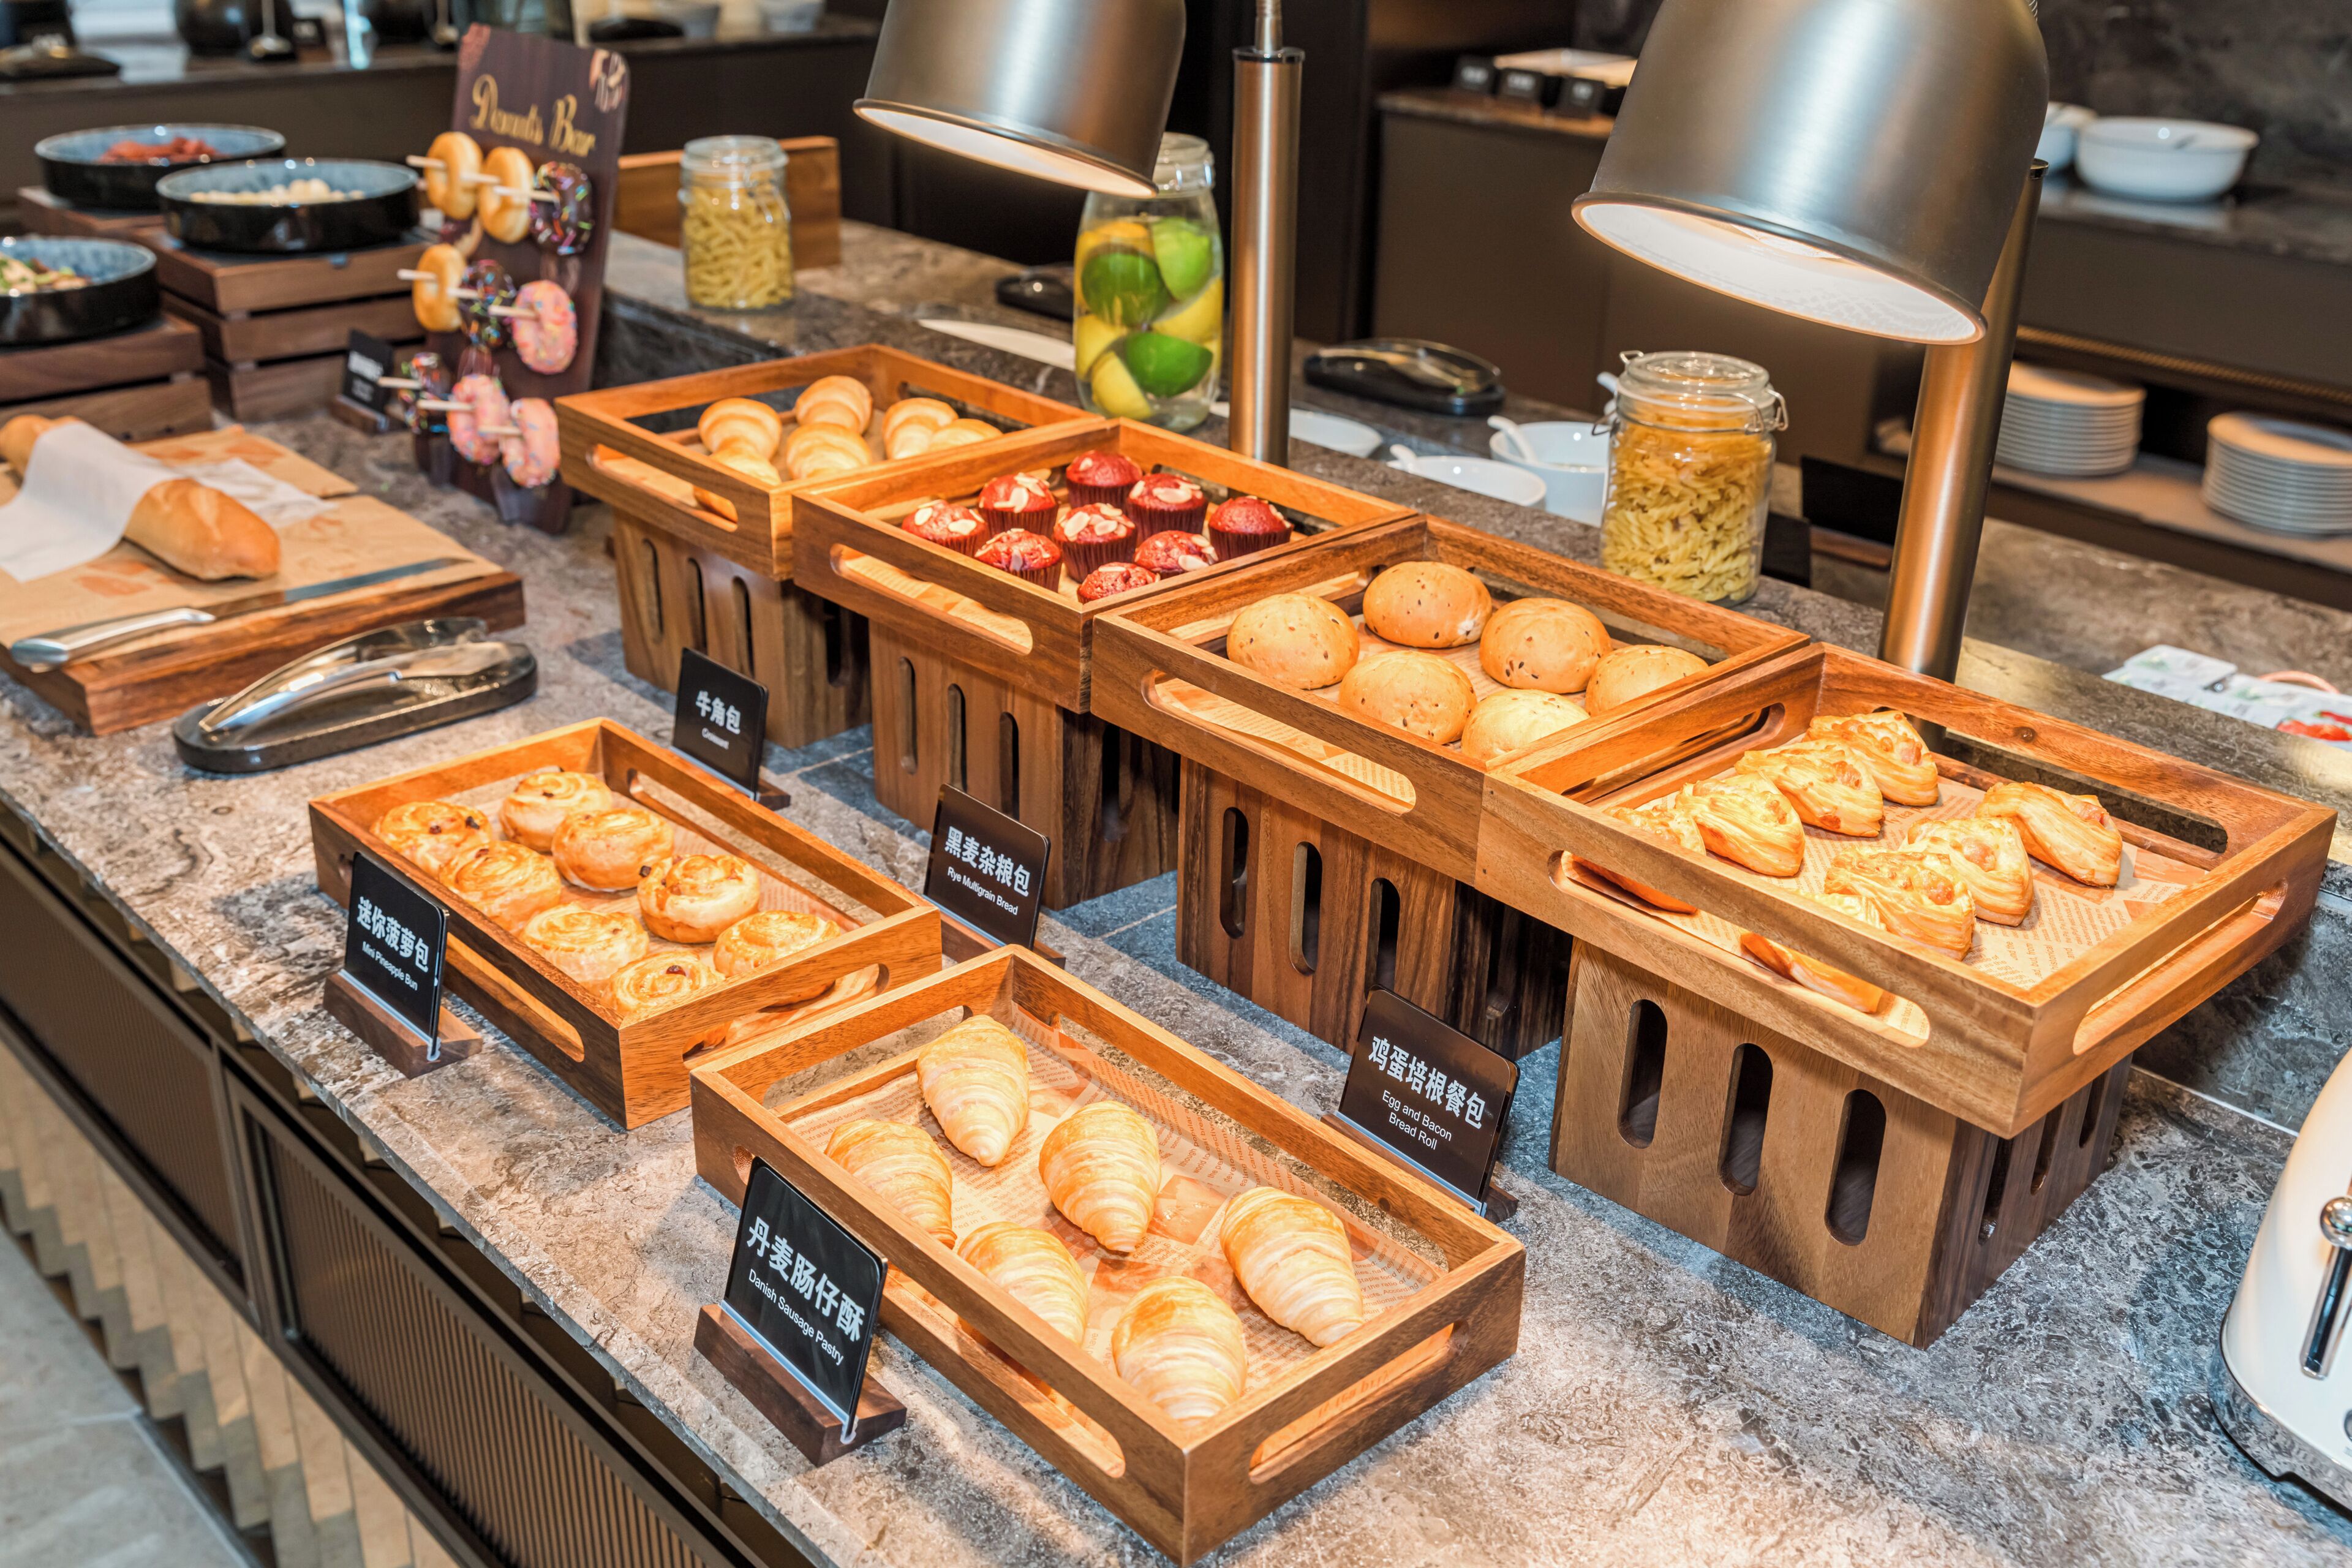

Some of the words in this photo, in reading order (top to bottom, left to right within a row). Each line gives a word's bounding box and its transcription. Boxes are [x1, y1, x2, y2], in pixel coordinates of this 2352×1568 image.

[549, 94, 597, 157] Bar
[695, 690, 741, 735] 牛角包
[944, 826, 1031, 897] 黑麦杂粮包
[947, 867, 962, 882] Rye
[962, 875, 996, 902] Multigrain
[997, 895, 1019, 916] Bread
[356, 896, 429, 973] 迷你菠萝包
[2064, 948, 2076, 959] and
[362, 941, 375, 959] Mini
[375, 951, 405, 981] Pineapple
[404, 973, 418, 991] Bun
[1368, 1036, 1486, 1129] 鸡蛋培根餐包
[828, 1117, 843, 1126] food
[843, 1107, 867, 1119] source
[1186, 1116, 1200, 1147] popular
[1382, 1090, 1401, 1112] Egg
[1402, 1105, 1421, 1121] and
[1422, 1115, 1452, 1142] Bacon
[1389, 1113, 1417, 1137] Bread
[1418, 1131, 1438, 1150] Roll
[746, 1216, 865, 1342] 丹麦肠仔酥
[1383, 1282, 1420, 1295] According
[748, 1268, 777, 1304] Danish
[778, 1297, 815, 1338] Sausage
[815, 1330, 845, 1366] Pastry
